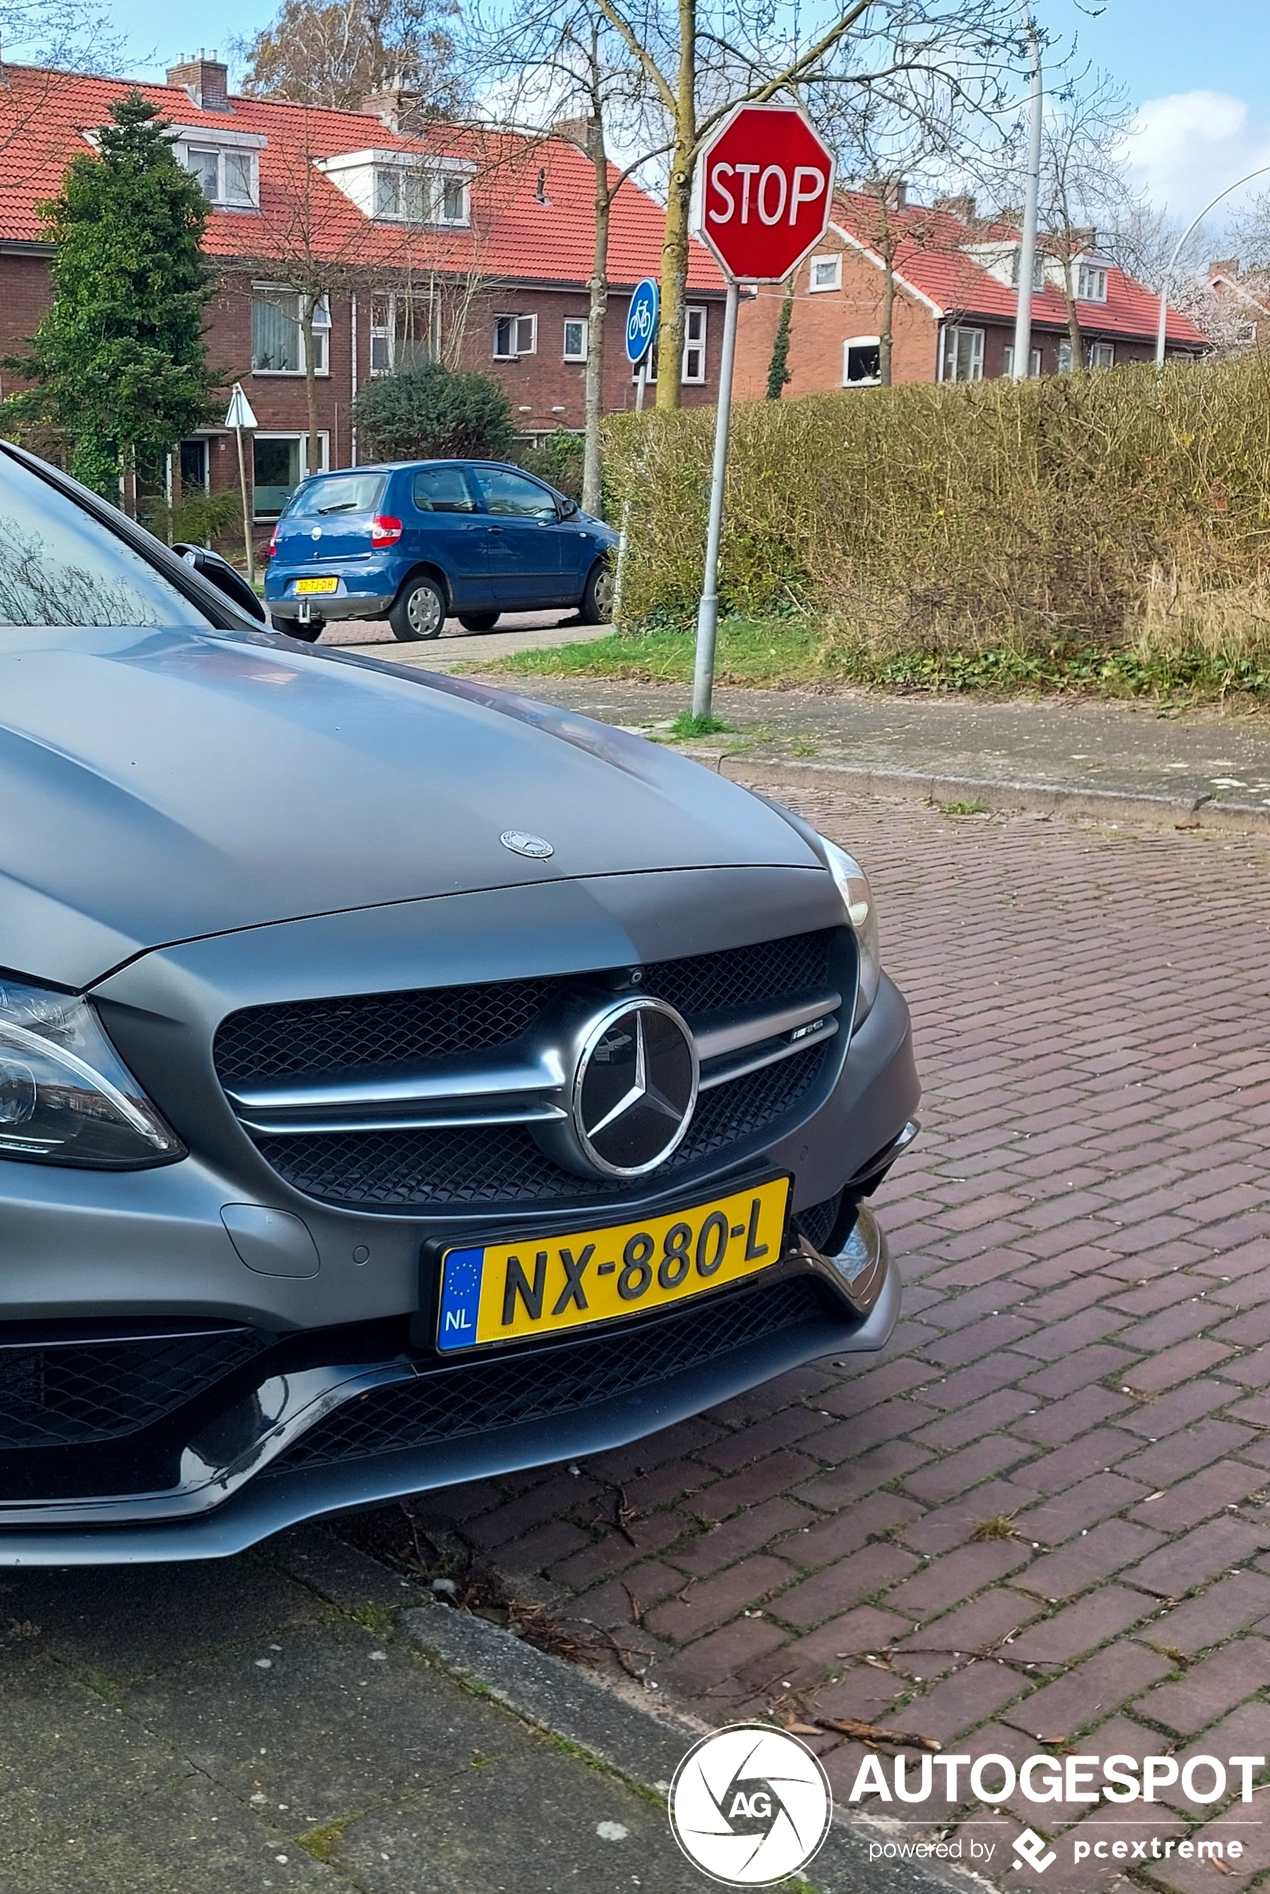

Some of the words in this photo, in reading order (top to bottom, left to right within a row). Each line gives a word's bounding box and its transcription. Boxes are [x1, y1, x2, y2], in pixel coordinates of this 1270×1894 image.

[709, 162, 825, 226] STOP
[298, 580, 334, 591] 32-TJ-DH
[501, 1198, 769, 1326] NX-880-L
[445, 1309, 472, 1331] NL
